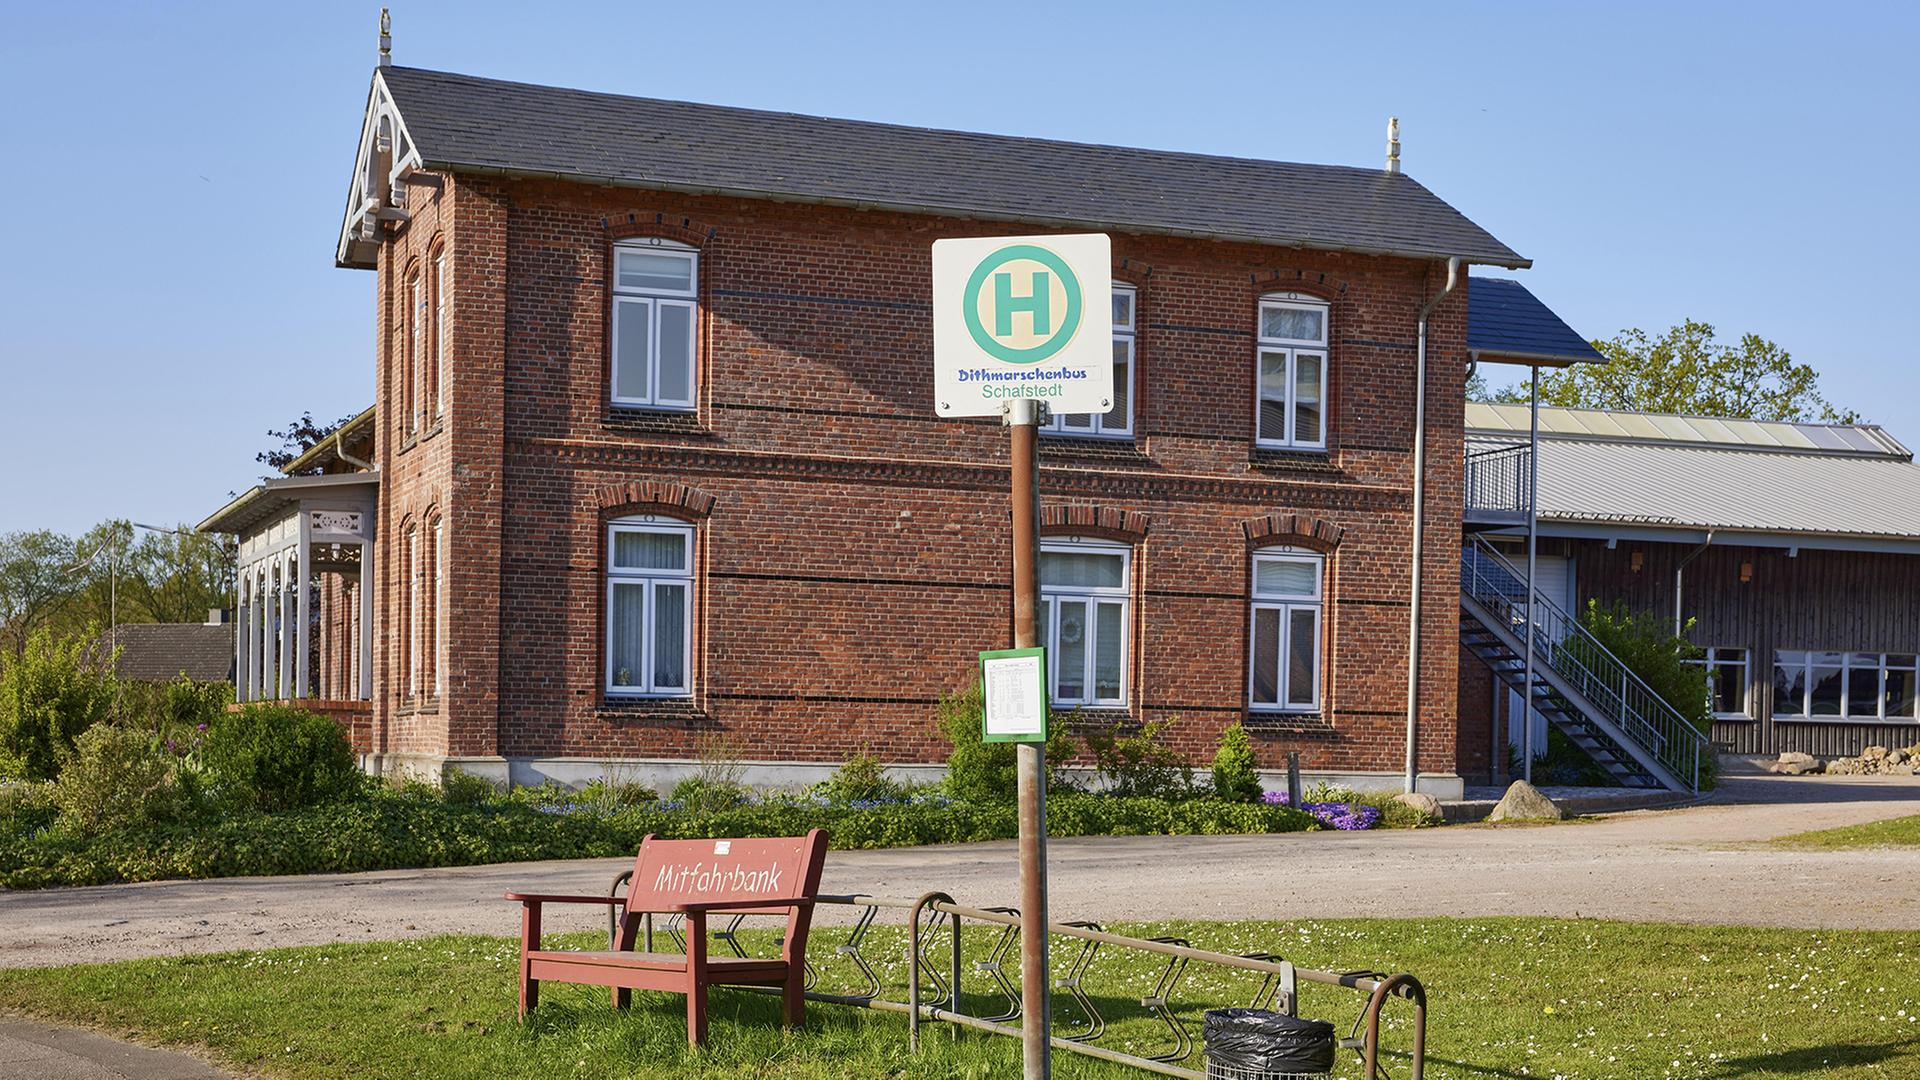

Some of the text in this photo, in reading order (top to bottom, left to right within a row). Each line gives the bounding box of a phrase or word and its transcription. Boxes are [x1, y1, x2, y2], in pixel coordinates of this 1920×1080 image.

[994, 271, 1050, 336] H
[958, 367, 1087, 382] Dithmarschenbus
[982, 383, 1063, 398] Schafstedt
[653, 861, 783, 894] Mitfahrbank
